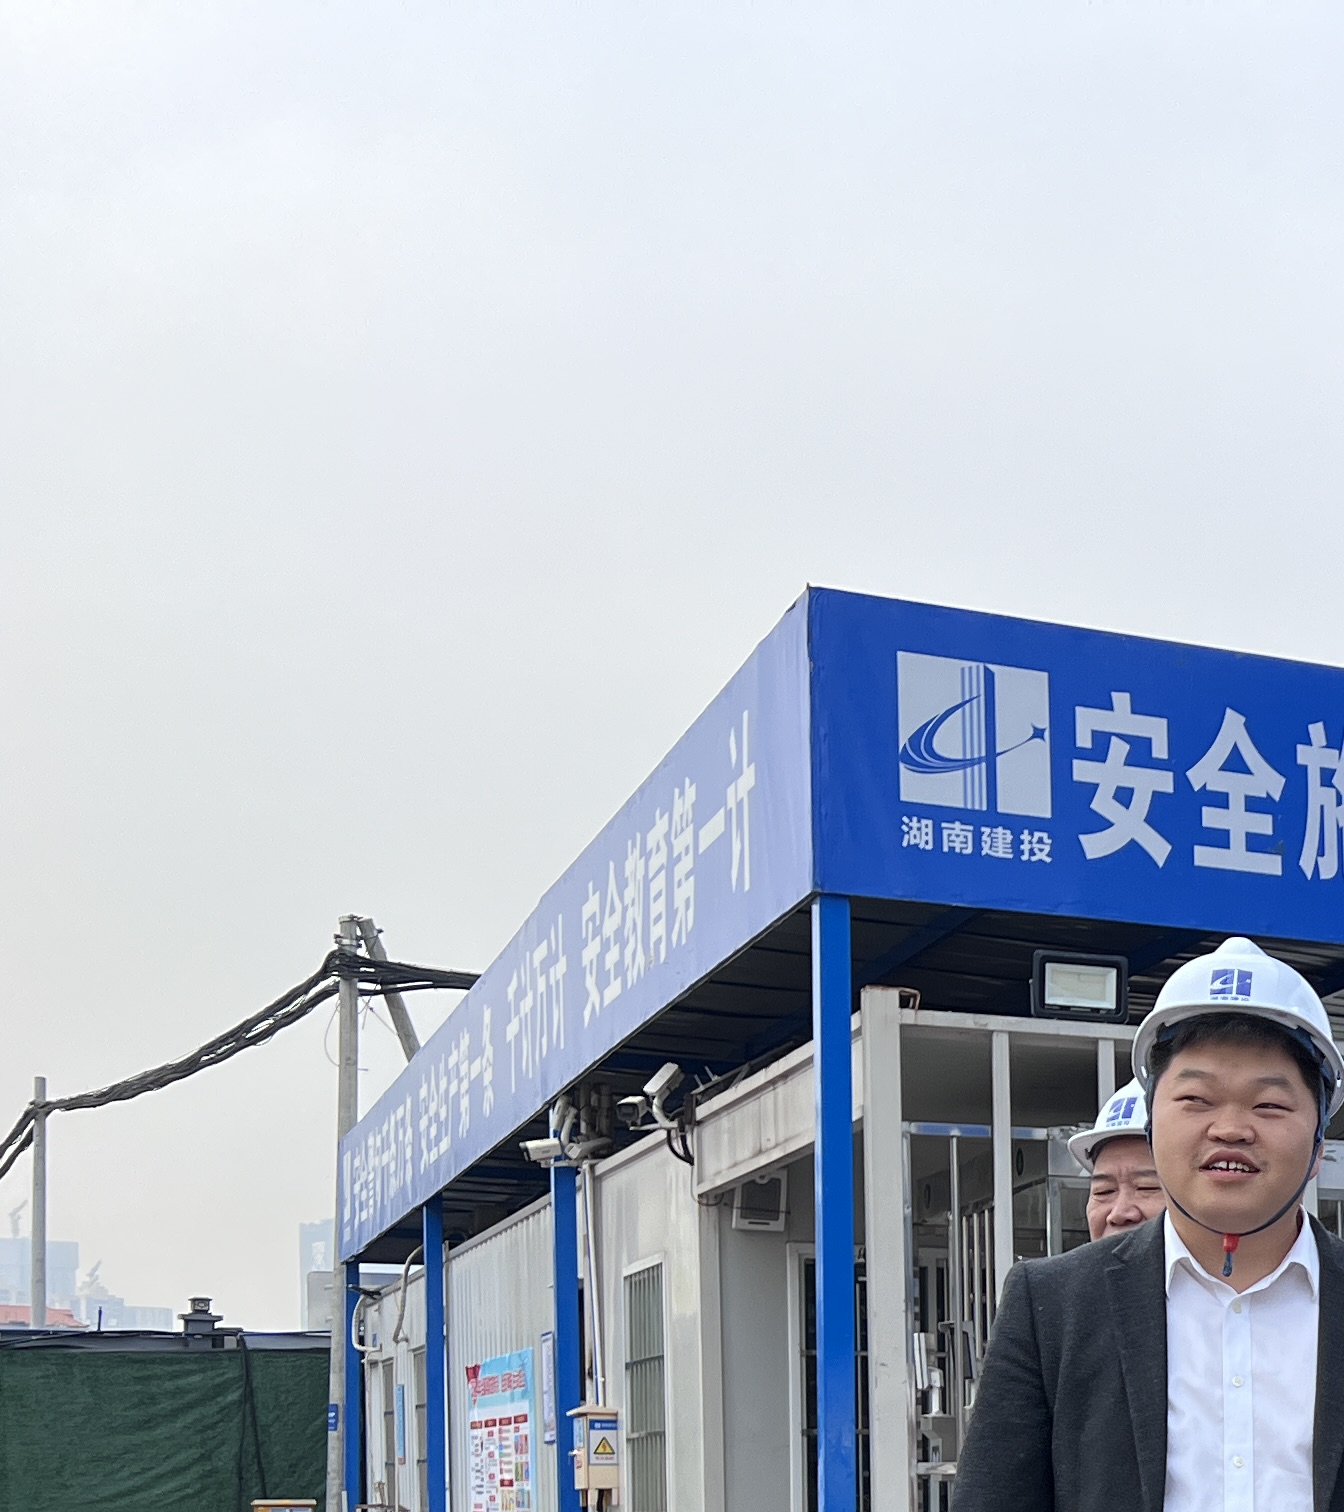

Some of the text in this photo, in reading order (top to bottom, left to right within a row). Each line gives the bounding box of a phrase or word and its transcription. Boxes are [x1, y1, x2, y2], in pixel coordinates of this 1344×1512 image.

[581, 709, 756, 1028] 安全教育第一计
[901, 816, 1053, 864] 湖南建投
